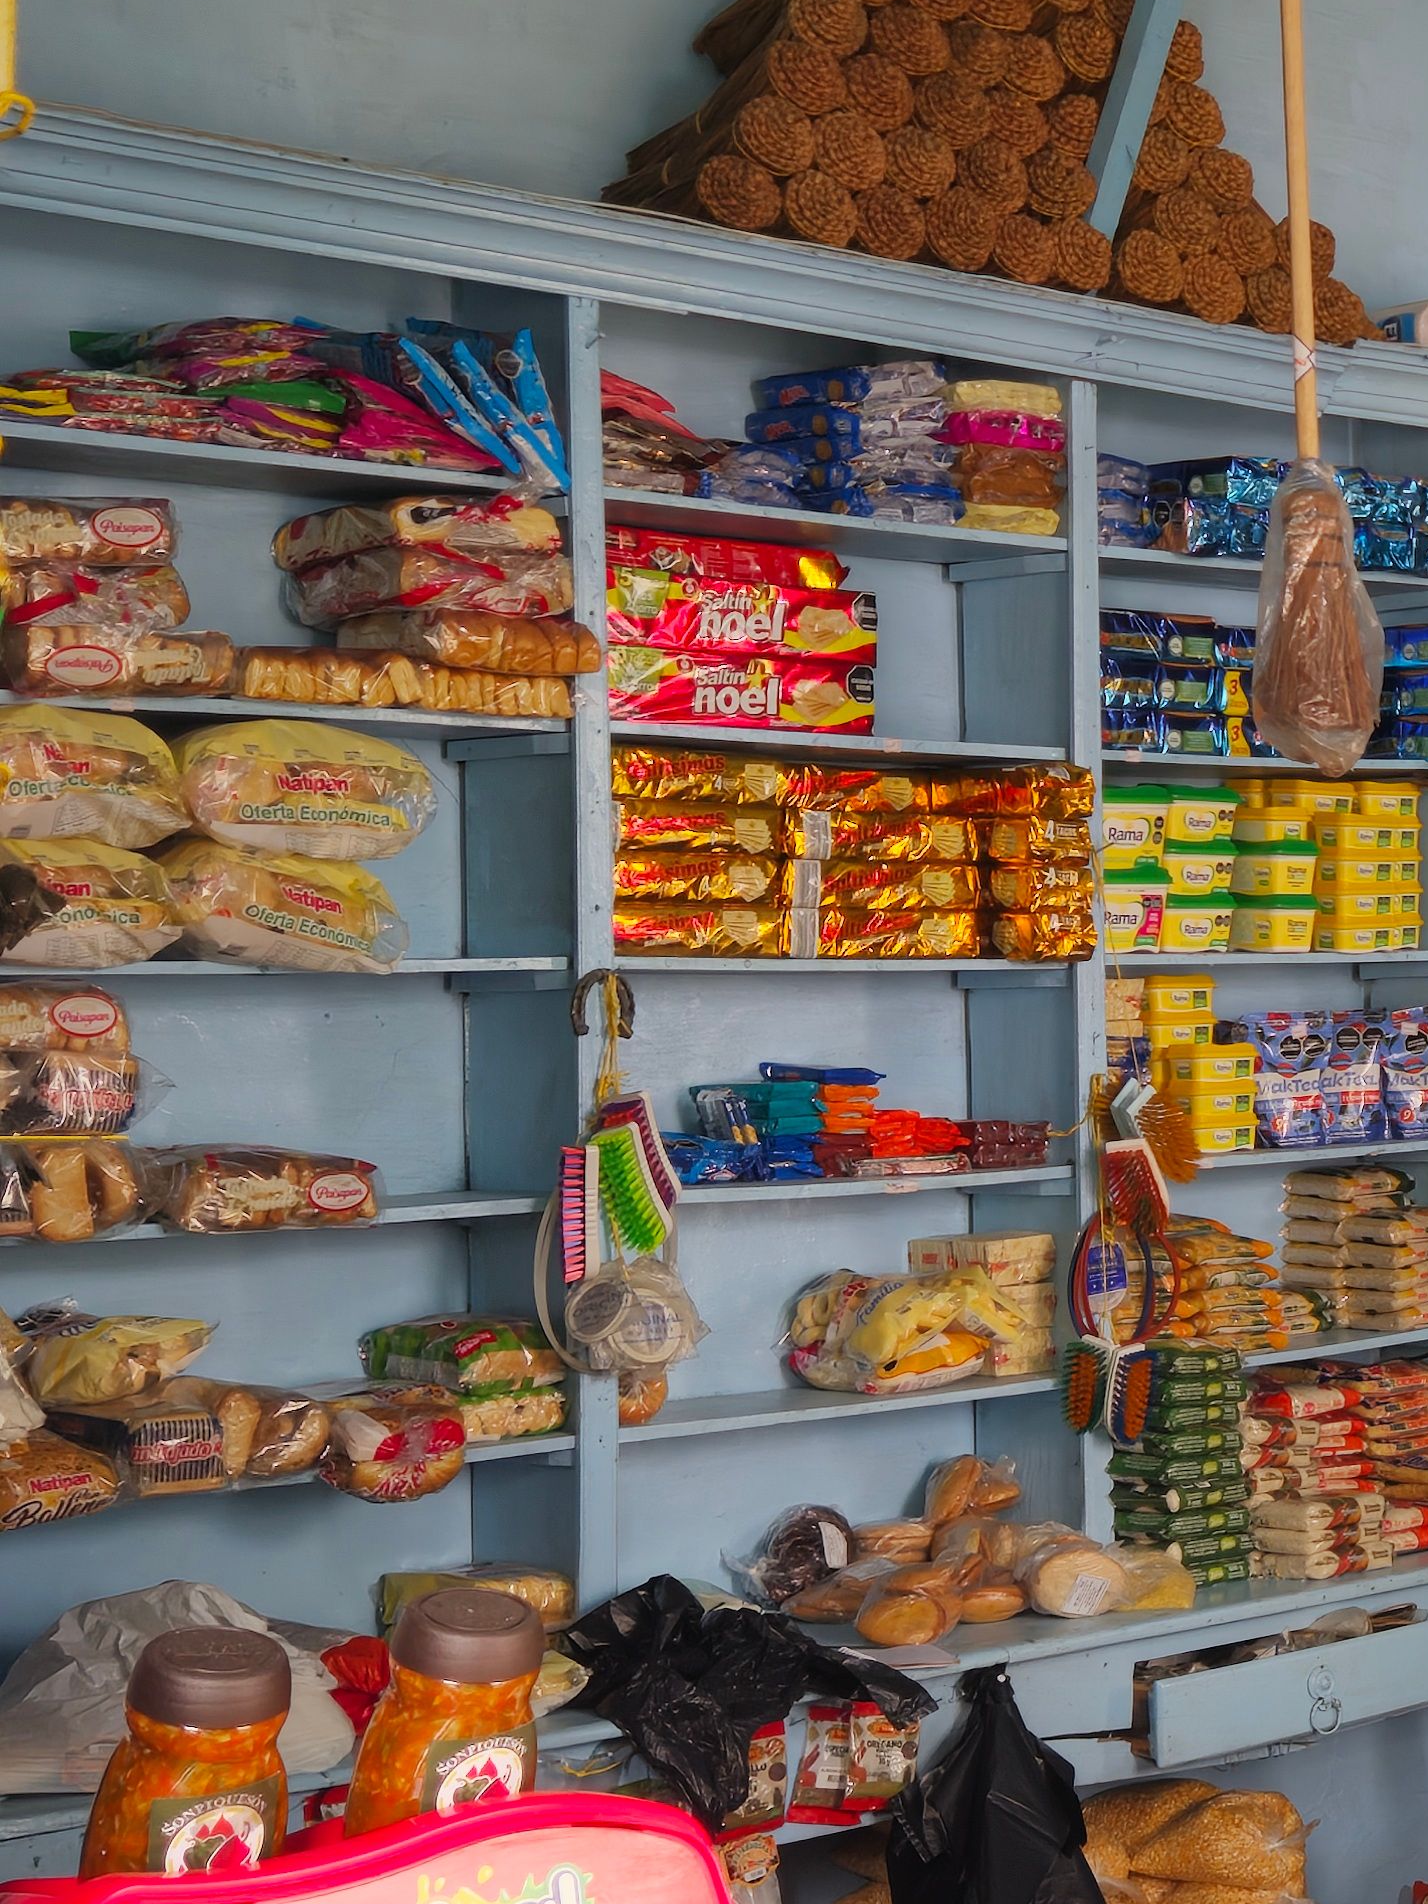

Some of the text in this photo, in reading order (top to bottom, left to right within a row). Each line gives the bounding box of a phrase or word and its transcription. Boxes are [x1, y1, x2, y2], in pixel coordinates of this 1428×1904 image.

[699, 602, 788, 643] noel
[693, 676, 782, 717] noel
[277, 773, 349, 794] Natipan
[241, 803, 391, 827] Oferta Económica
[1188, 816, 1212, 829] Rama
[1109, 827, 1144, 842] Rama
[1186, 870, 1211, 882] Rama
[282, 886, 343, 914] Natipan
[245, 904, 295, 930] Oferta
[1103, 911, 1139, 926] Rama
[1184, 924, 1209, 936] Rama
[1402, 1108, 1412, 1121] 9
[855, 1280, 905, 1327] Familia
[29, 1473, 93, 1494] Natipan
